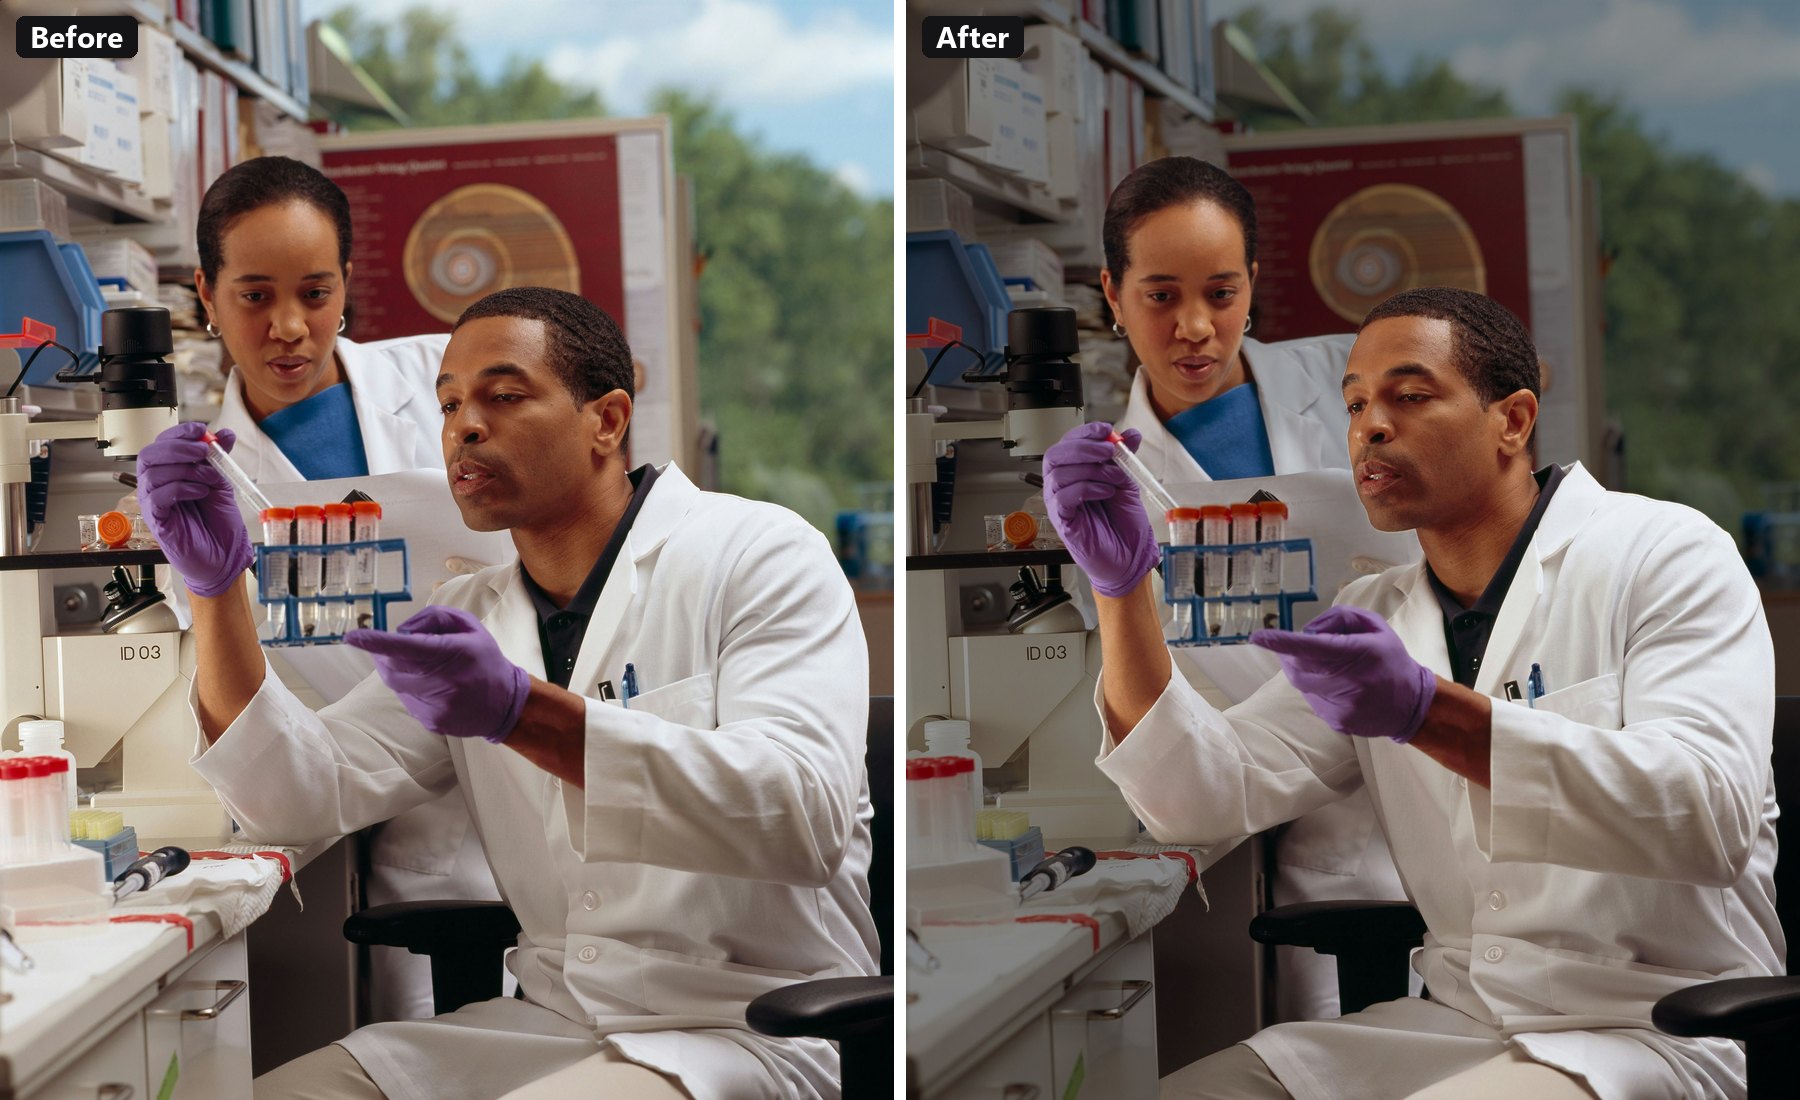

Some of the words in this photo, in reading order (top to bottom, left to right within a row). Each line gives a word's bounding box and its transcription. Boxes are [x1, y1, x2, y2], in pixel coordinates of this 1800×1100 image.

[120, 645, 135, 661] ID
[138, 645, 161, 661] 03
[1026, 645, 1041, 661] ID
[1044, 645, 1067, 661] 03
